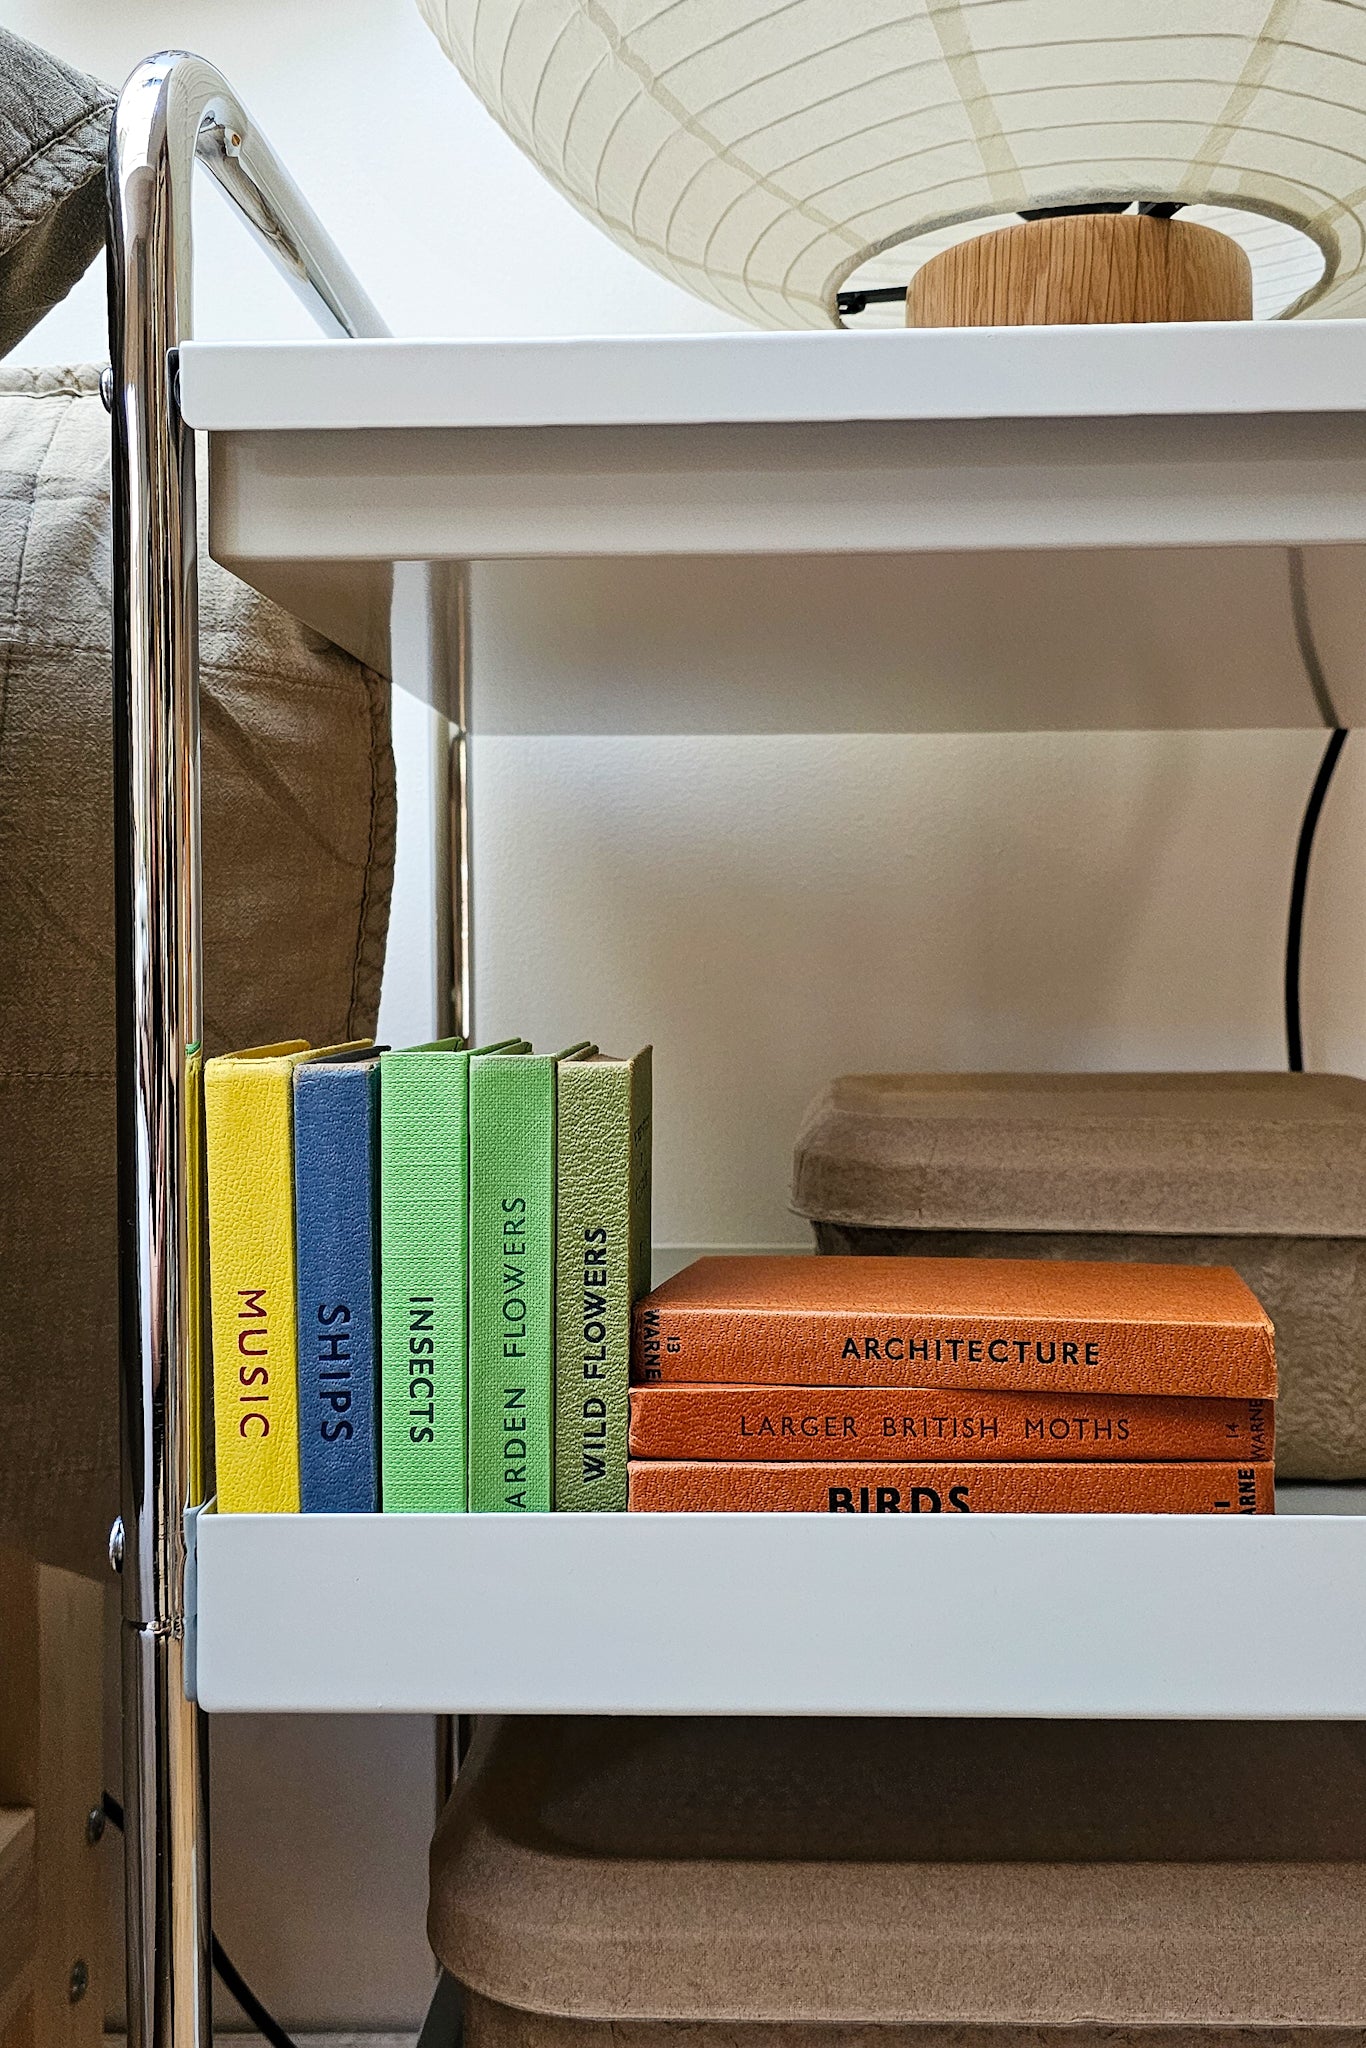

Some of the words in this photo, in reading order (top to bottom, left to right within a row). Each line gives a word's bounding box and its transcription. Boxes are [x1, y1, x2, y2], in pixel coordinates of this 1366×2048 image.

[502, 1197, 527, 1358] FLOWERS
[582, 1228, 607, 1379] FLOWERS
[237, 1289, 270, 1438] MUSIC
[317, 1304, 354, 1442] SHIPS
[408, 1297, 434, 1443] INSECTS
[643, 1309, 661, 1379] WARNE
[666, 1336, 681, 1353] 13
[841, 1337, 1099, 1366] ARCHITECTURE
[503, 1388, 527, 1509] ARDEN
[582, 1397, 607, 1483] WILD
[740, 1415, 858, 1437] LARGER
[883, 1416, 998, 1439] BRITISH
[1025, 1417, 1130, 1441] MOTHS
[1225, 1422, 1239, 1438] 14
[1248, 1399, 1265, 1460] WARNE
[828, 1486, 971, 1513] BIRDS
